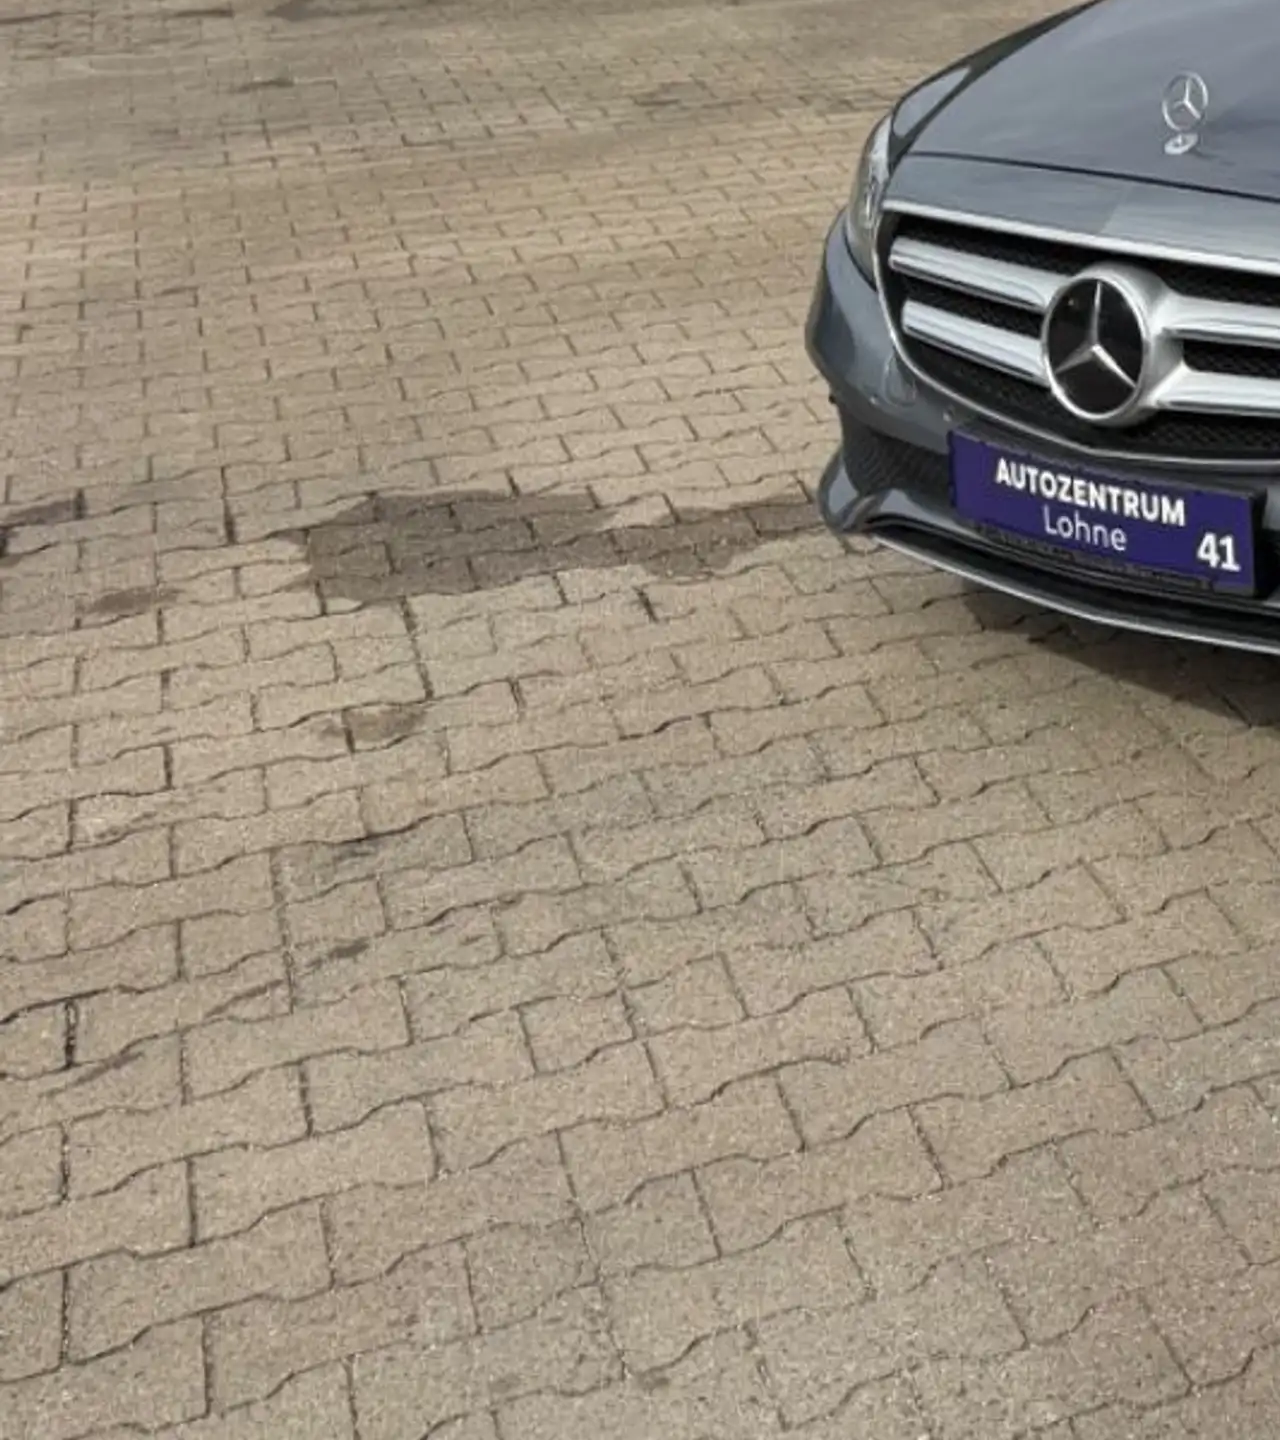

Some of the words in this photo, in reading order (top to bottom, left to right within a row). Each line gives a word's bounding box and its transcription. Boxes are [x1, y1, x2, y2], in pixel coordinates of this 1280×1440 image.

[995, 457, 1186, 527] AUTOZENTRUM
[1042, 504, 1128, 551] Lohne
[1196, 532, 1242, 573] 41
